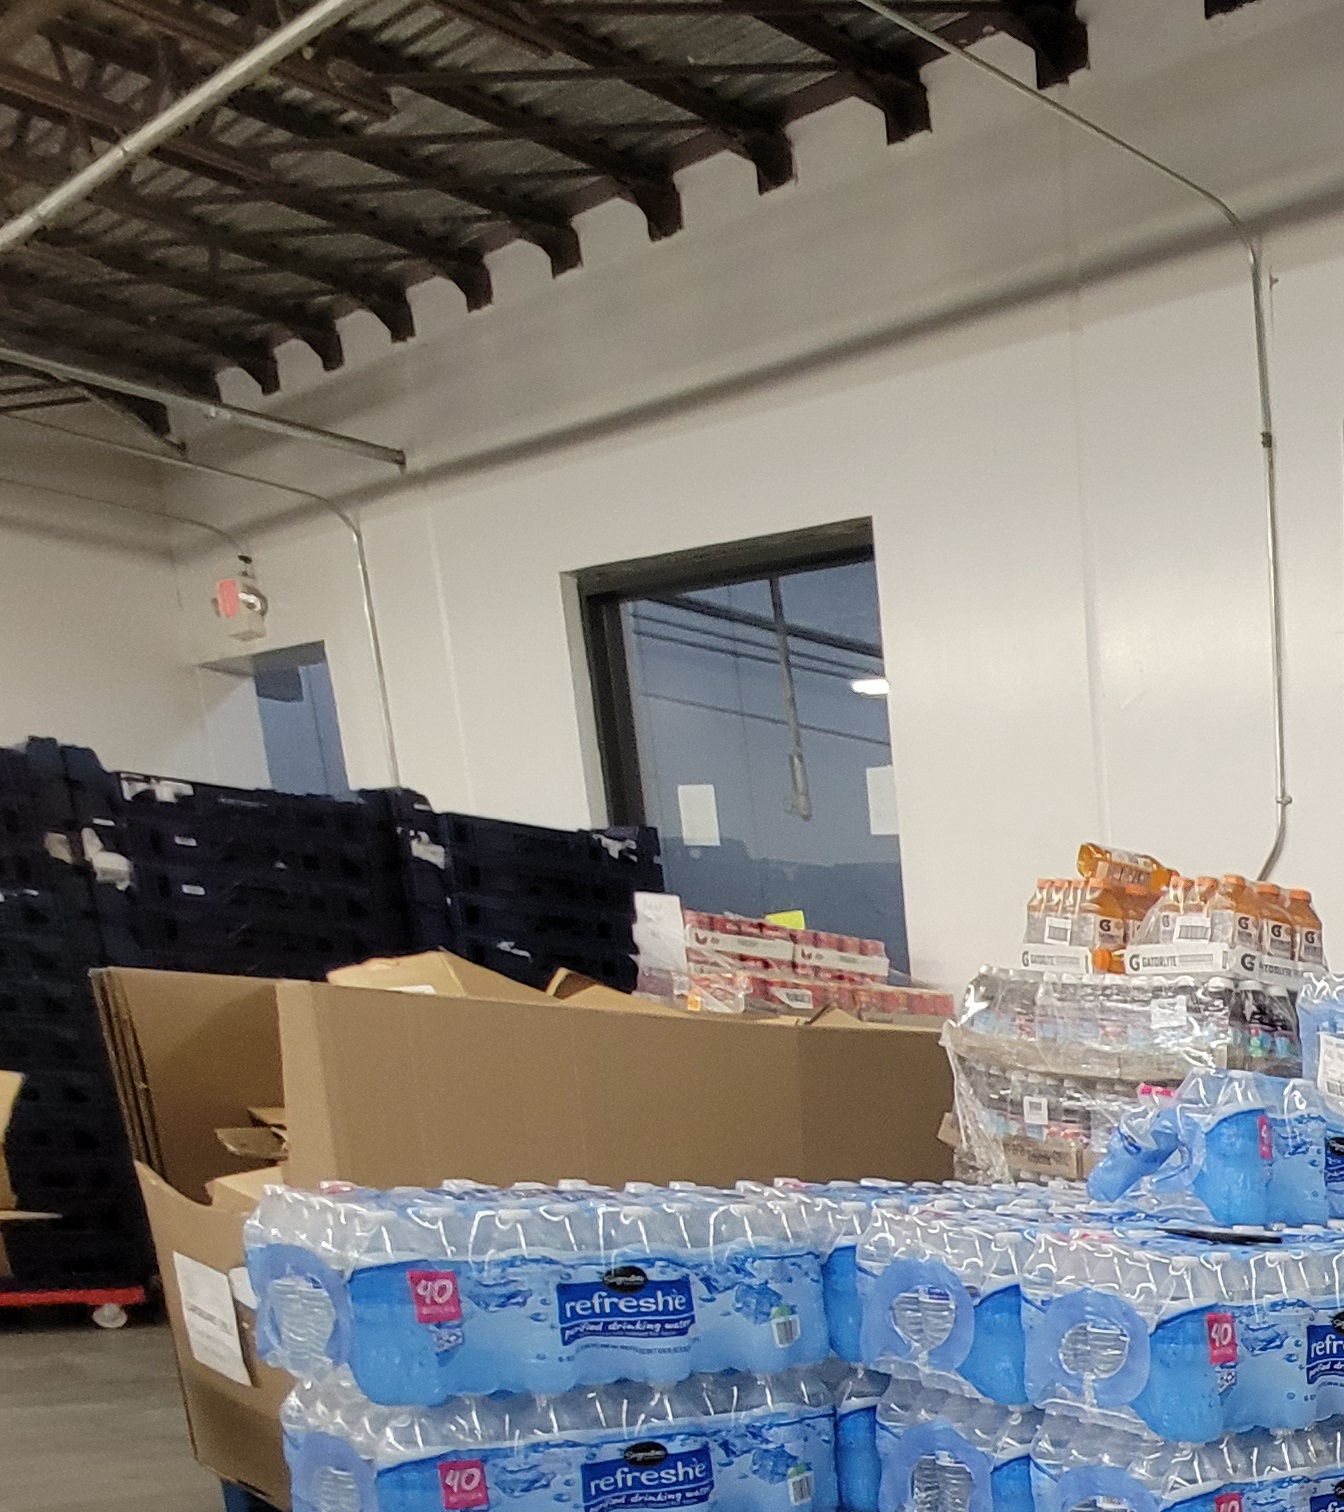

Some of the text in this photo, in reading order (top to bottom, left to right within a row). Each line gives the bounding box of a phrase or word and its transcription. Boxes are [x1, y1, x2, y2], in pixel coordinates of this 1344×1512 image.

[1237, 916, 1250, 930] G
[1271, 924, 1282, 938] G
[1304, 930, 1315, 944] G
[1129, 954, 1140, 971] G
[1240, 953, 1255, 972] G
[416, 1278, 454, 1306] 40
[1210, 1323, 1233, 1348] 40
[445, 1467, 481, 1493] 40
